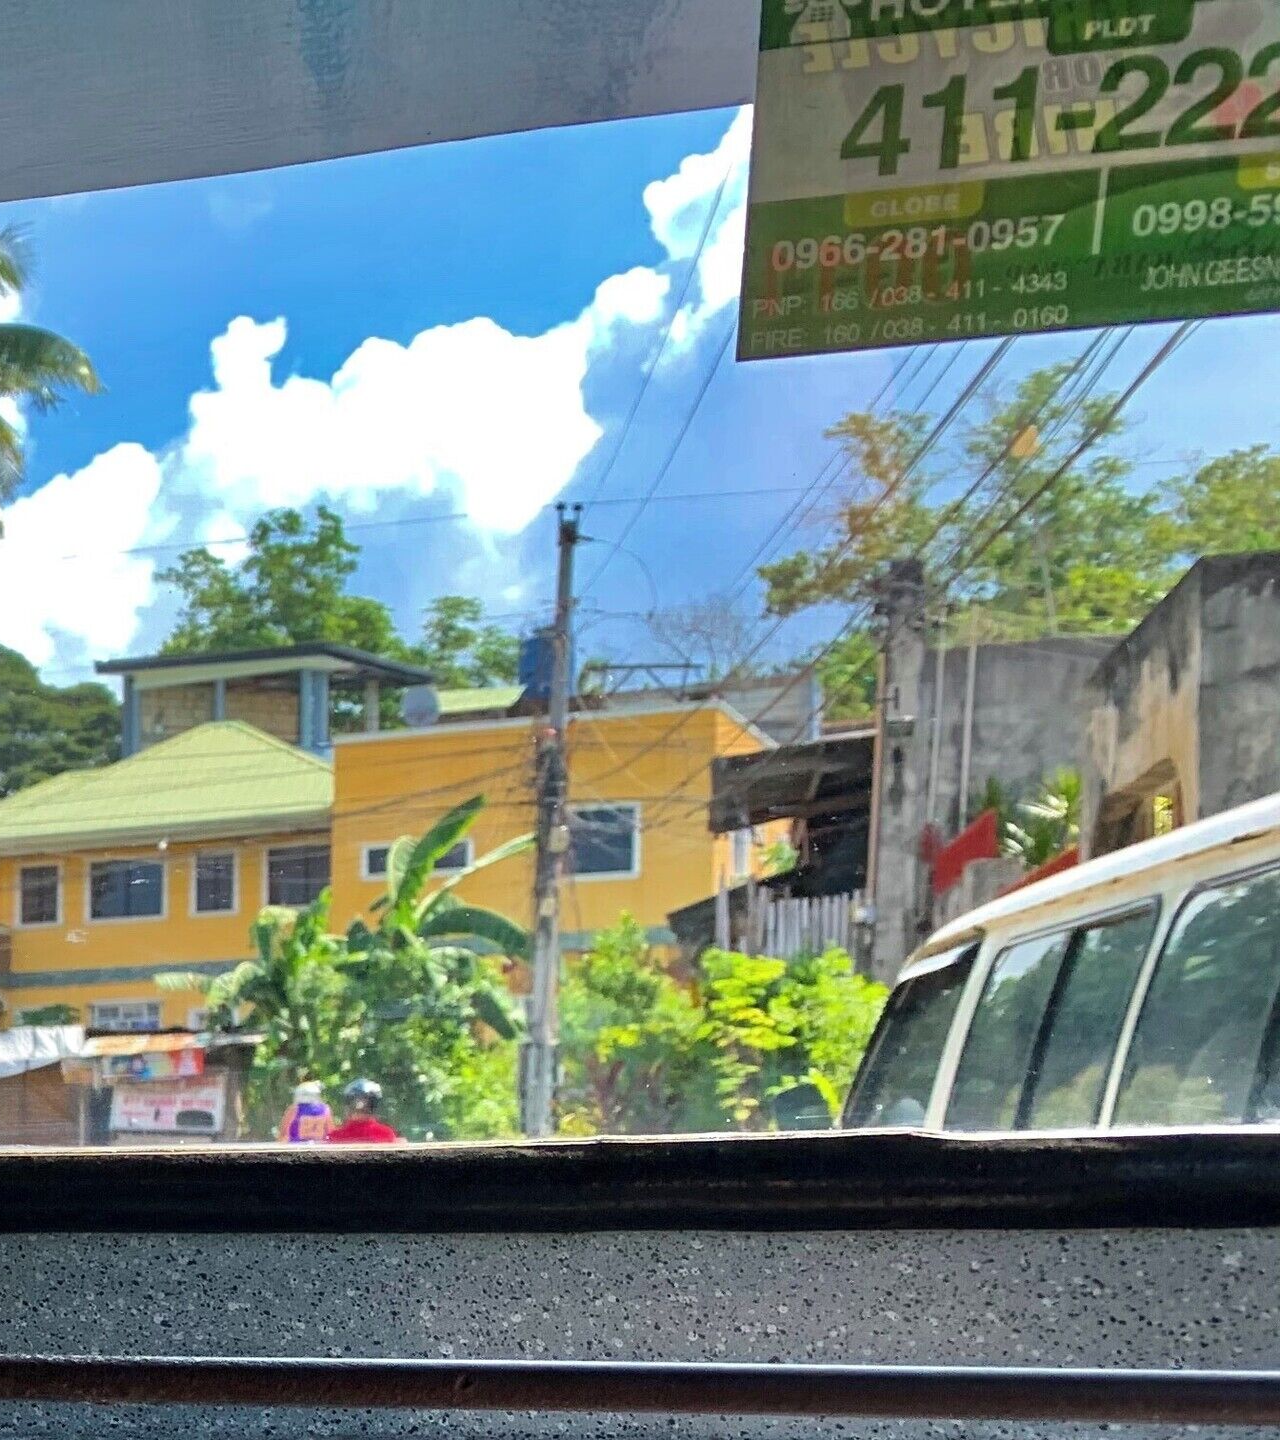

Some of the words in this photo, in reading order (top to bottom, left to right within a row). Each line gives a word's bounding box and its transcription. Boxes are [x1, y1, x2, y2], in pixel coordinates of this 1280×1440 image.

[1083, 13, 1156, 41] PLDT
[871, 193, 960, 219] GLOBE
[1132, 193, 1280, 237] 0998-5
[771, 213, 1066, 272] 0966-281-0957
[1012, 271, 1068, 294] 4343
[1013, 304, 1068, 328] 0160
